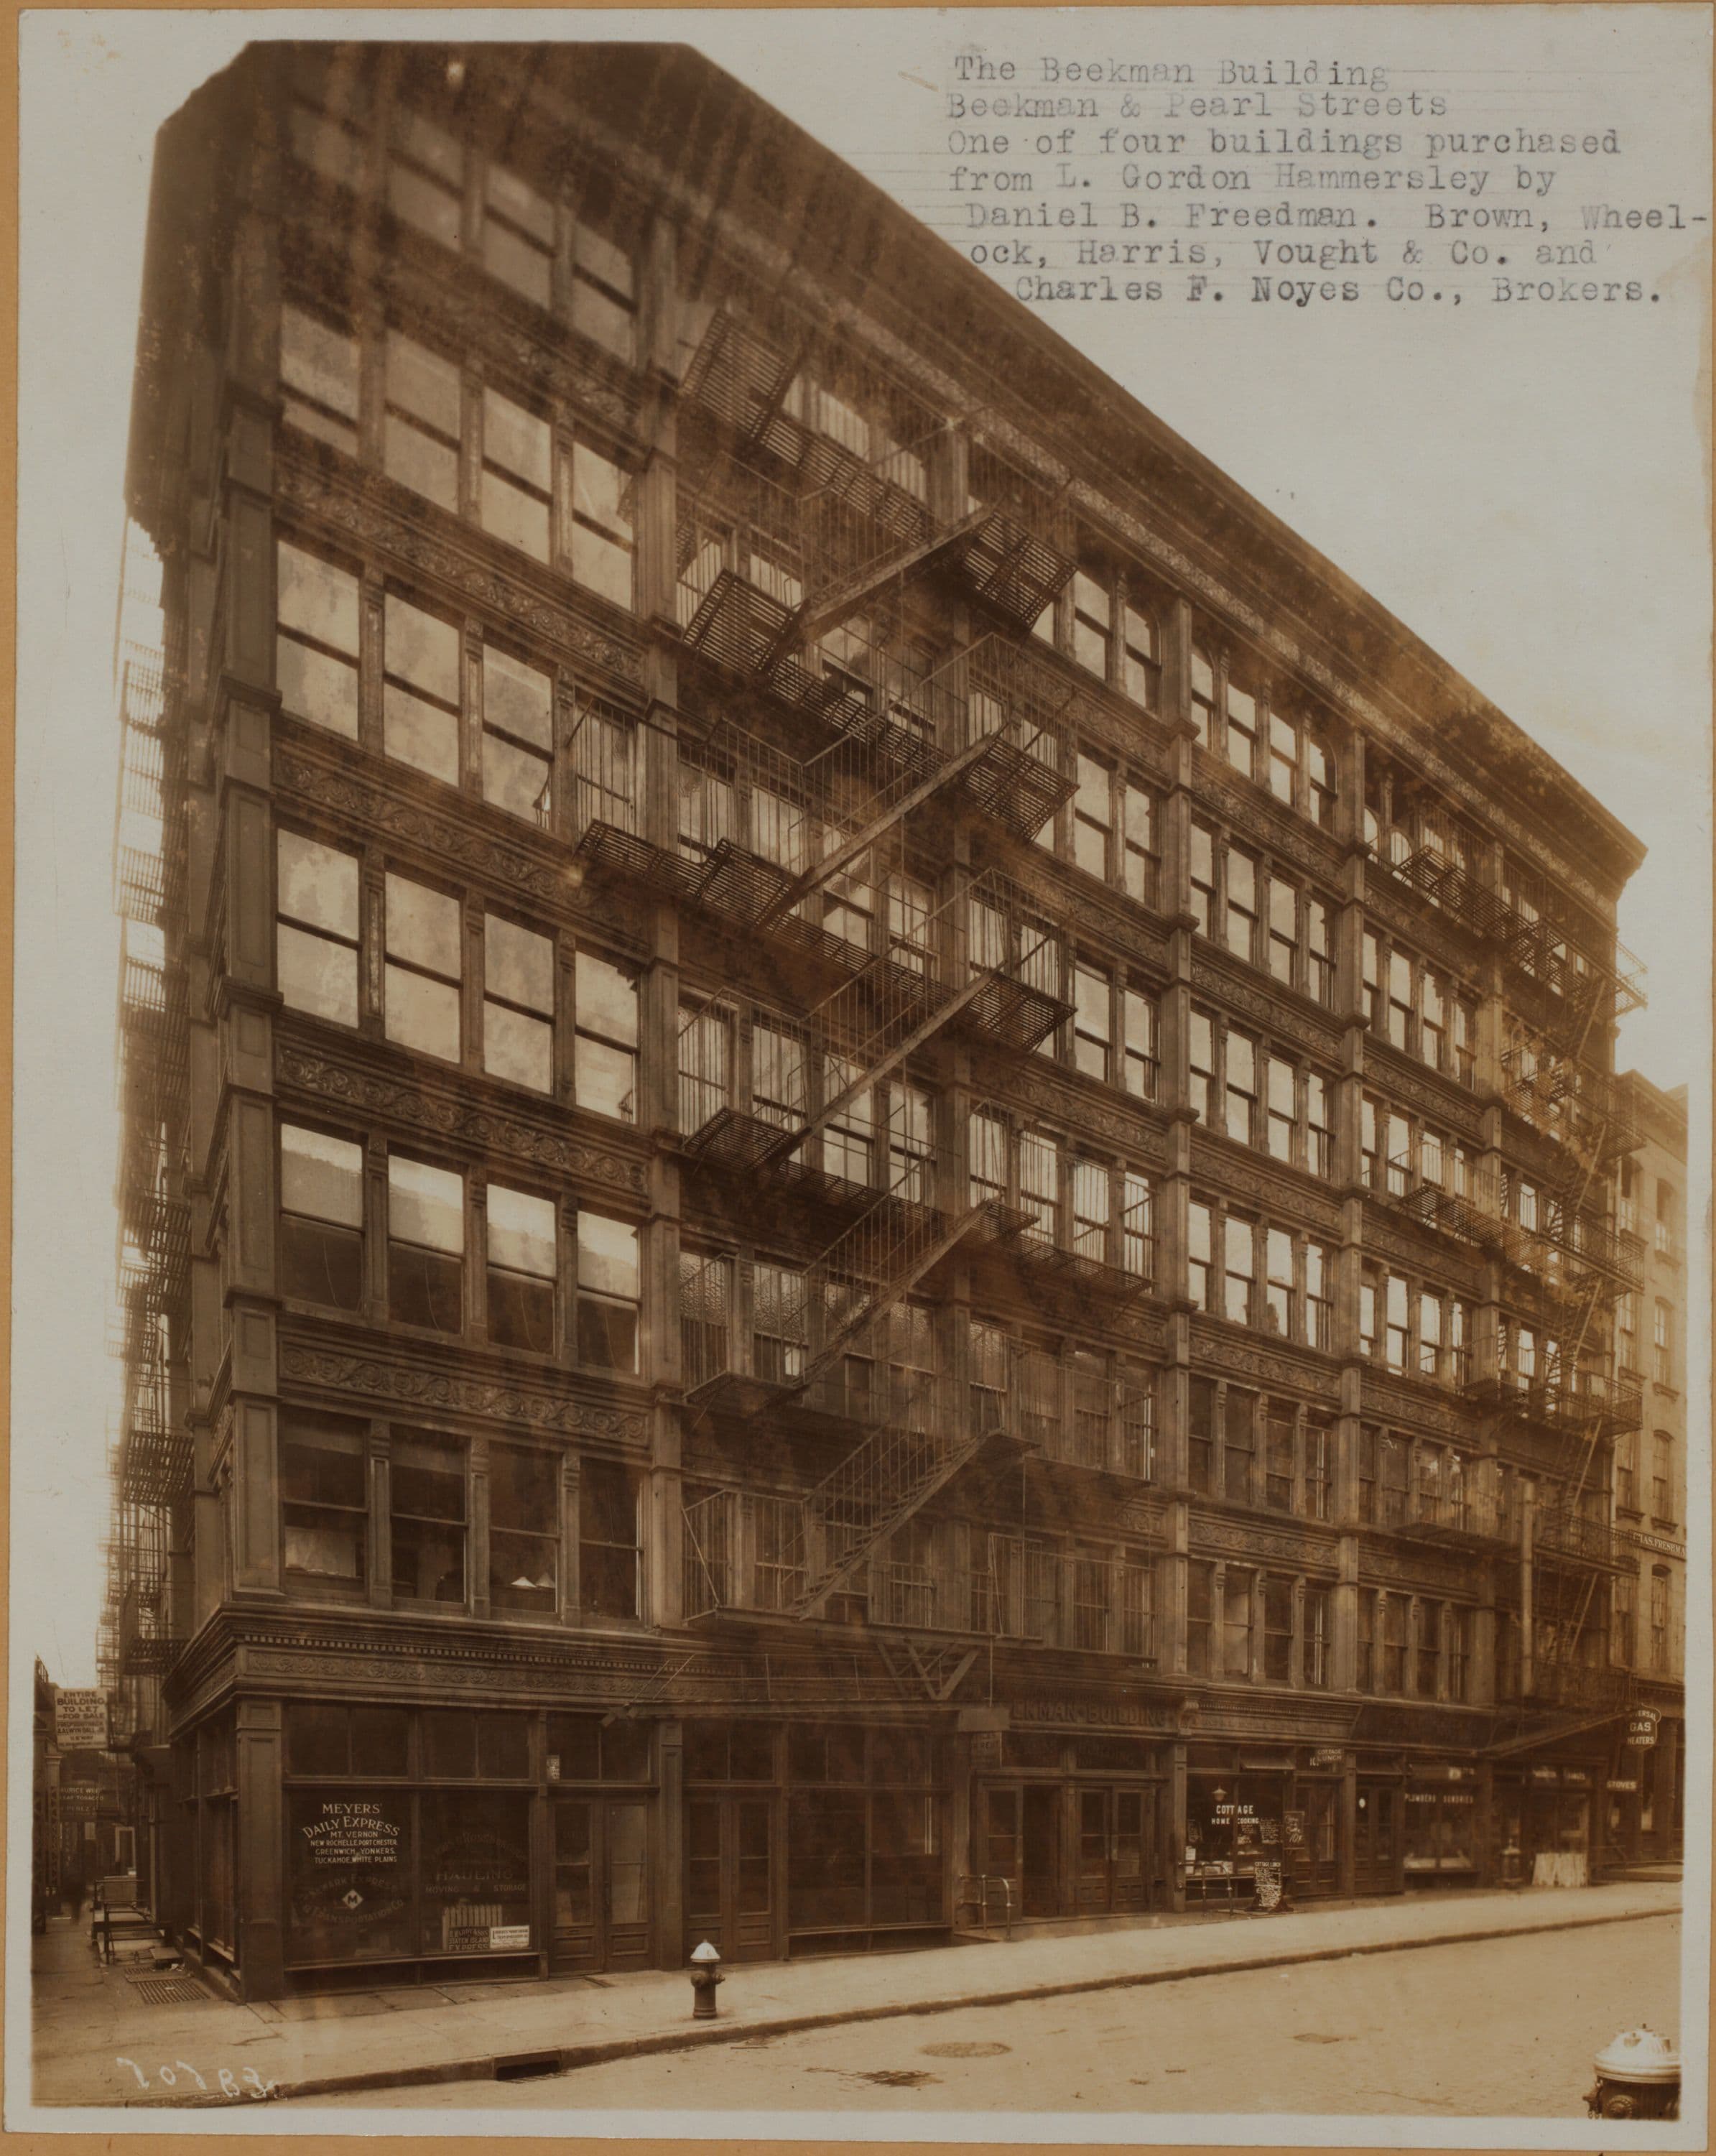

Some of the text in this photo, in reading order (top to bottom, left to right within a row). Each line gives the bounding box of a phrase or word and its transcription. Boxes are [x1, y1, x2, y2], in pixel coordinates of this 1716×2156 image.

[1654, 1537, 1686, 1557] FRESHMA
[57, 1697, 105, 1706] BUILDING
[1011, 1699, 1076, 1722] EKMAN
[1629, 1721, 1652, 1733] GAS
[1626, 1735, 1656, 1746] HEATERS
[1317, 1754, 1342, 1763] LUNCH
[1606, 1780, 1638, 1790] STOVES
[1215, 1805, 1254, 1815] COTTAGE
[302, 1815, 401, 1839] DAILY EXPRESS
[348, 1894, 358, 1904] M
